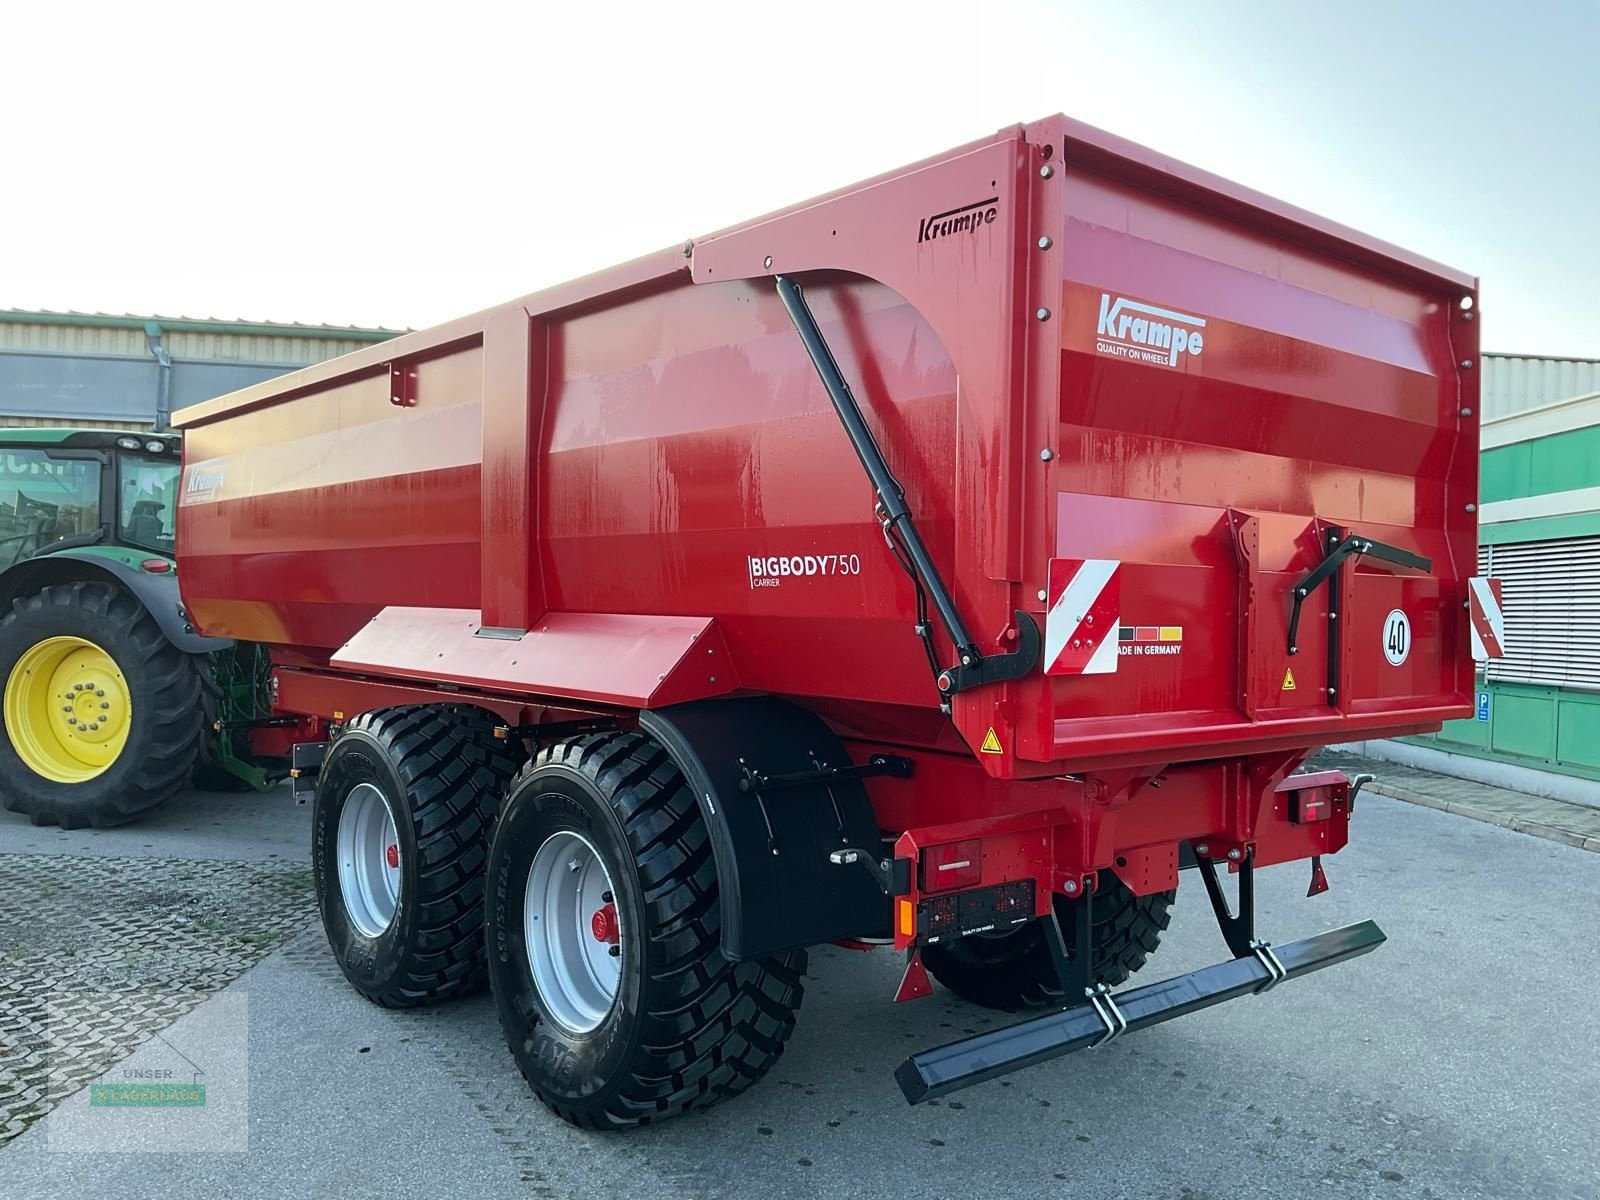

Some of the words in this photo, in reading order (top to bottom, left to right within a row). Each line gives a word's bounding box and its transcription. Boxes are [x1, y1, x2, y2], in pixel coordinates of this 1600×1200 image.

[918, 197, 999, 243] Krampe
[1096, 293, 1206, 368] Krampe
[1096, 342, 1127, 359] QUALITY
[1128, 349, 1141, 360] ON
[1140, 351, 1169, 366] WHEELS
[753, 578, 780, 587] CARRIER
[1388, 620, 1405, 655] 40
[1117, 645, 1132, 655] ADE
[1134, 645, 1143, 655] IN
[1144, 645, 1182, 655] GERMANY
[1480, 694, 1490, 708] P
